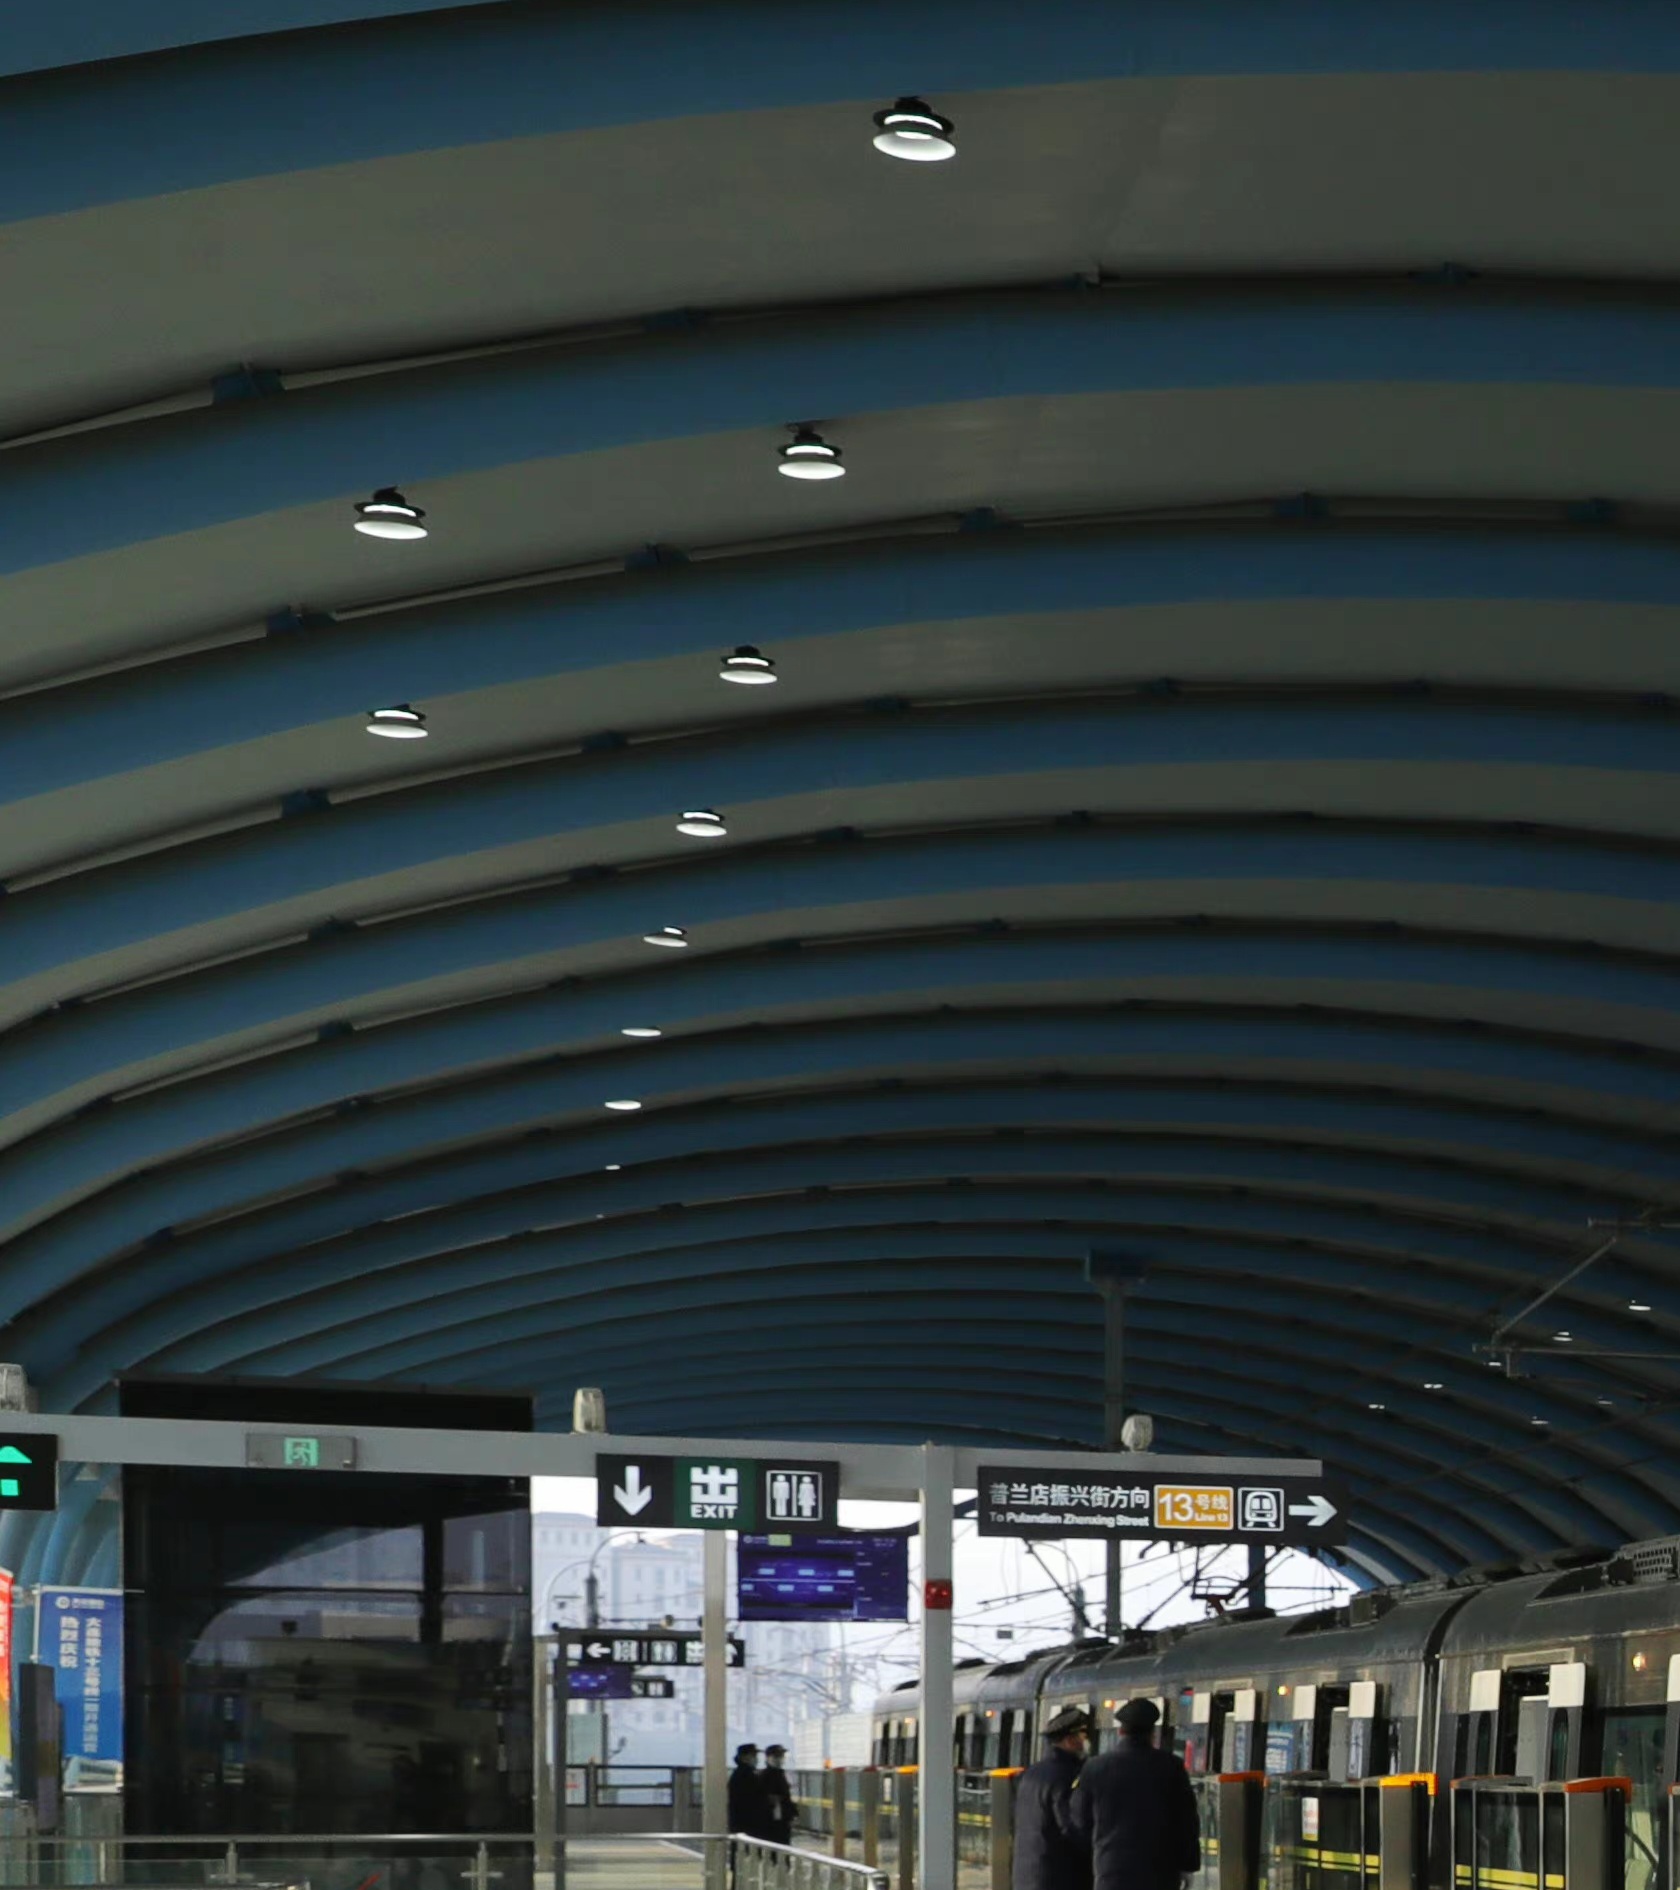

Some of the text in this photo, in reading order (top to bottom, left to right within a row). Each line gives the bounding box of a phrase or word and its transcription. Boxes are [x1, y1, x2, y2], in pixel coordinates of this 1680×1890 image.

[690, 1465, 739, 1503] 出
[989, 1482, 1150, 1510] 普兰店振兴街方向
[1159, 1492, 1229, 1522] 13 号线
[690, 1504, 739, 1520] EXIT
[989, 1510, 1150, 1528] To Pulandian Zhenxing Street
[1196, 1511, 1229, 1523] Line 13
